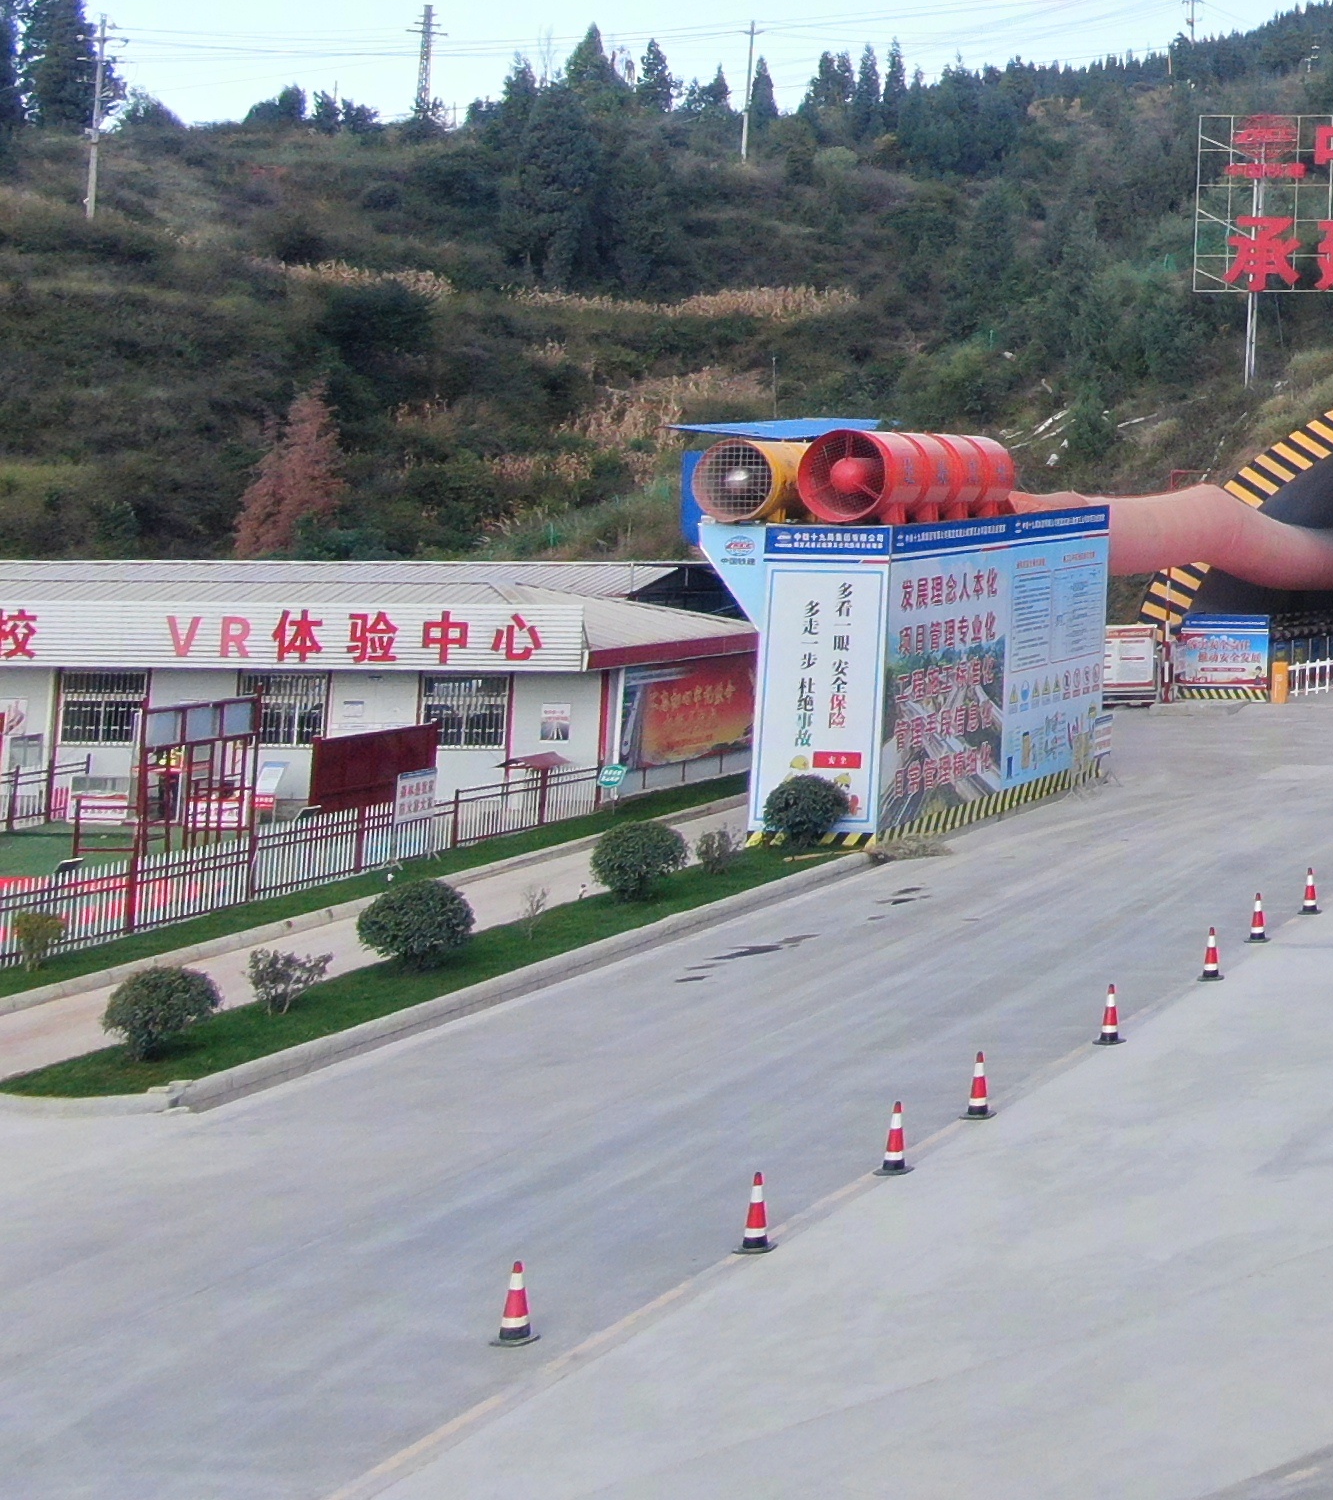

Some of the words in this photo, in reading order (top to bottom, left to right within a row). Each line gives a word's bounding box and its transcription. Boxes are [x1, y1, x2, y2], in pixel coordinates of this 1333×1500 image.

[720, 557, 756, 566] 中国铁建
[832, 581, 853, 651] 多看一眼
[900, 567, 999, 613] 发展理念人本化
[0, 609, 38, 660] 校
[166, 609, 542, 663] VR体验中心
[800, 599, 821, 670] 多走一步
[898, 611, 997, 658] 项目管理专业化
[793, 677, 816, 748] 杜绝事故
[828, 659, 850, 730] 安全保险
[893, 701, 994, 752] 管理手段信息化
